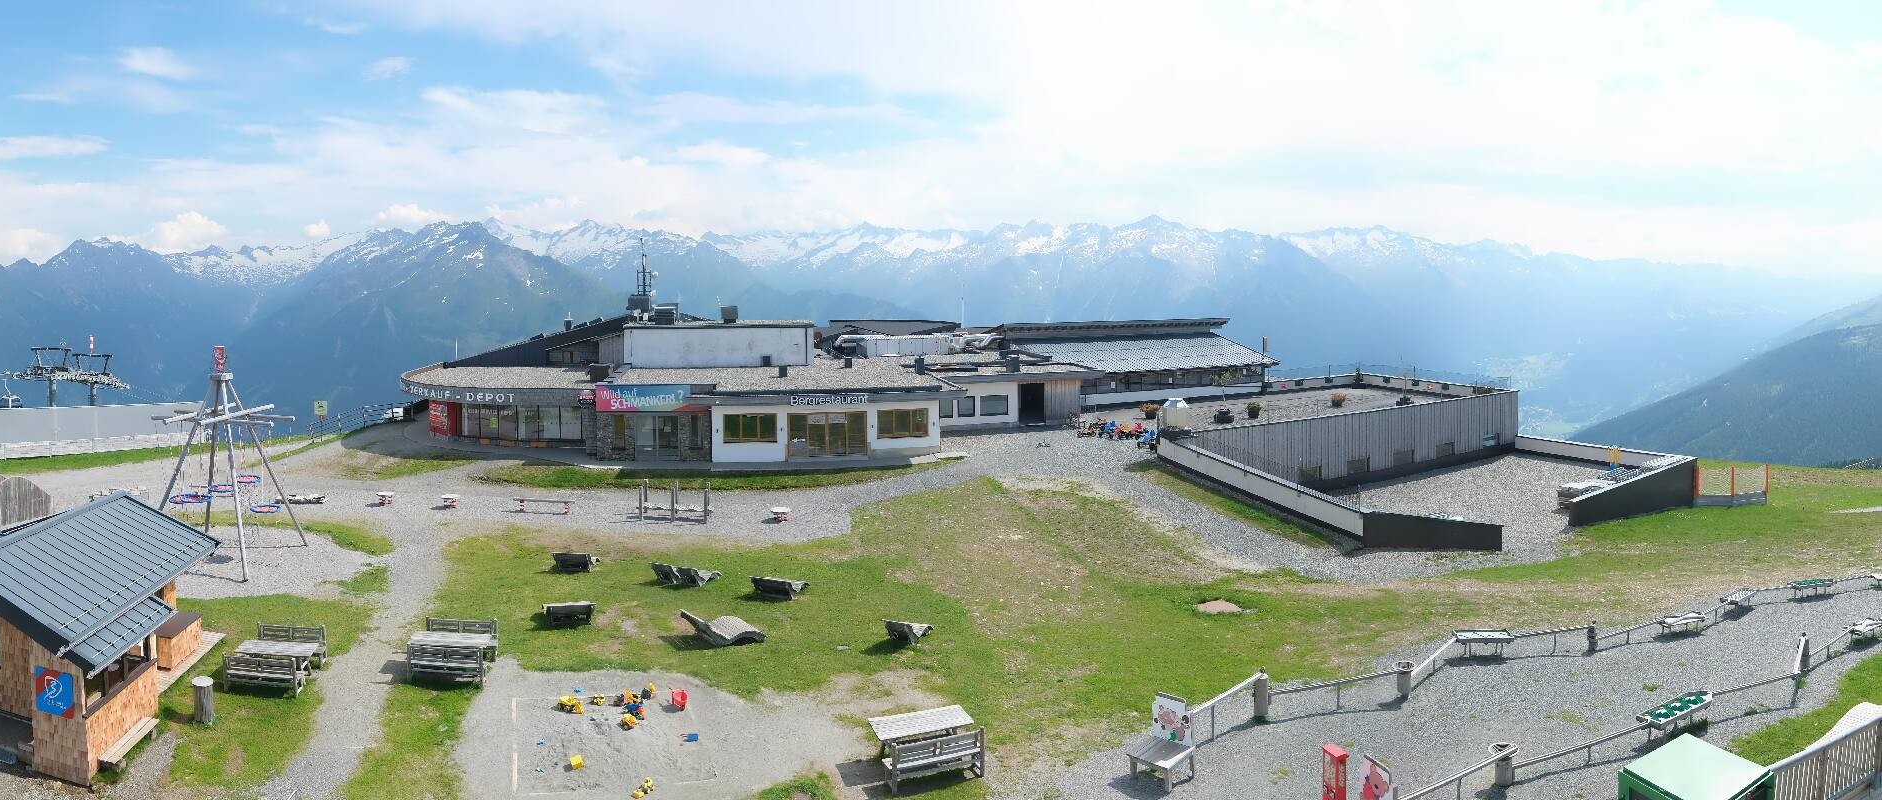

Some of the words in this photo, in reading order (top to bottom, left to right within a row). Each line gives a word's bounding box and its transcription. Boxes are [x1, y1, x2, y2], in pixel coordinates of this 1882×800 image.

[410, 386, 451, 400] VERKAUF
[466, 393, 515, 403] DEPOT
[600, 388, 621, 400] Wild
[622, 387, 638, 399] auf
[790, 394, 869, 406] Bergrestaurant
